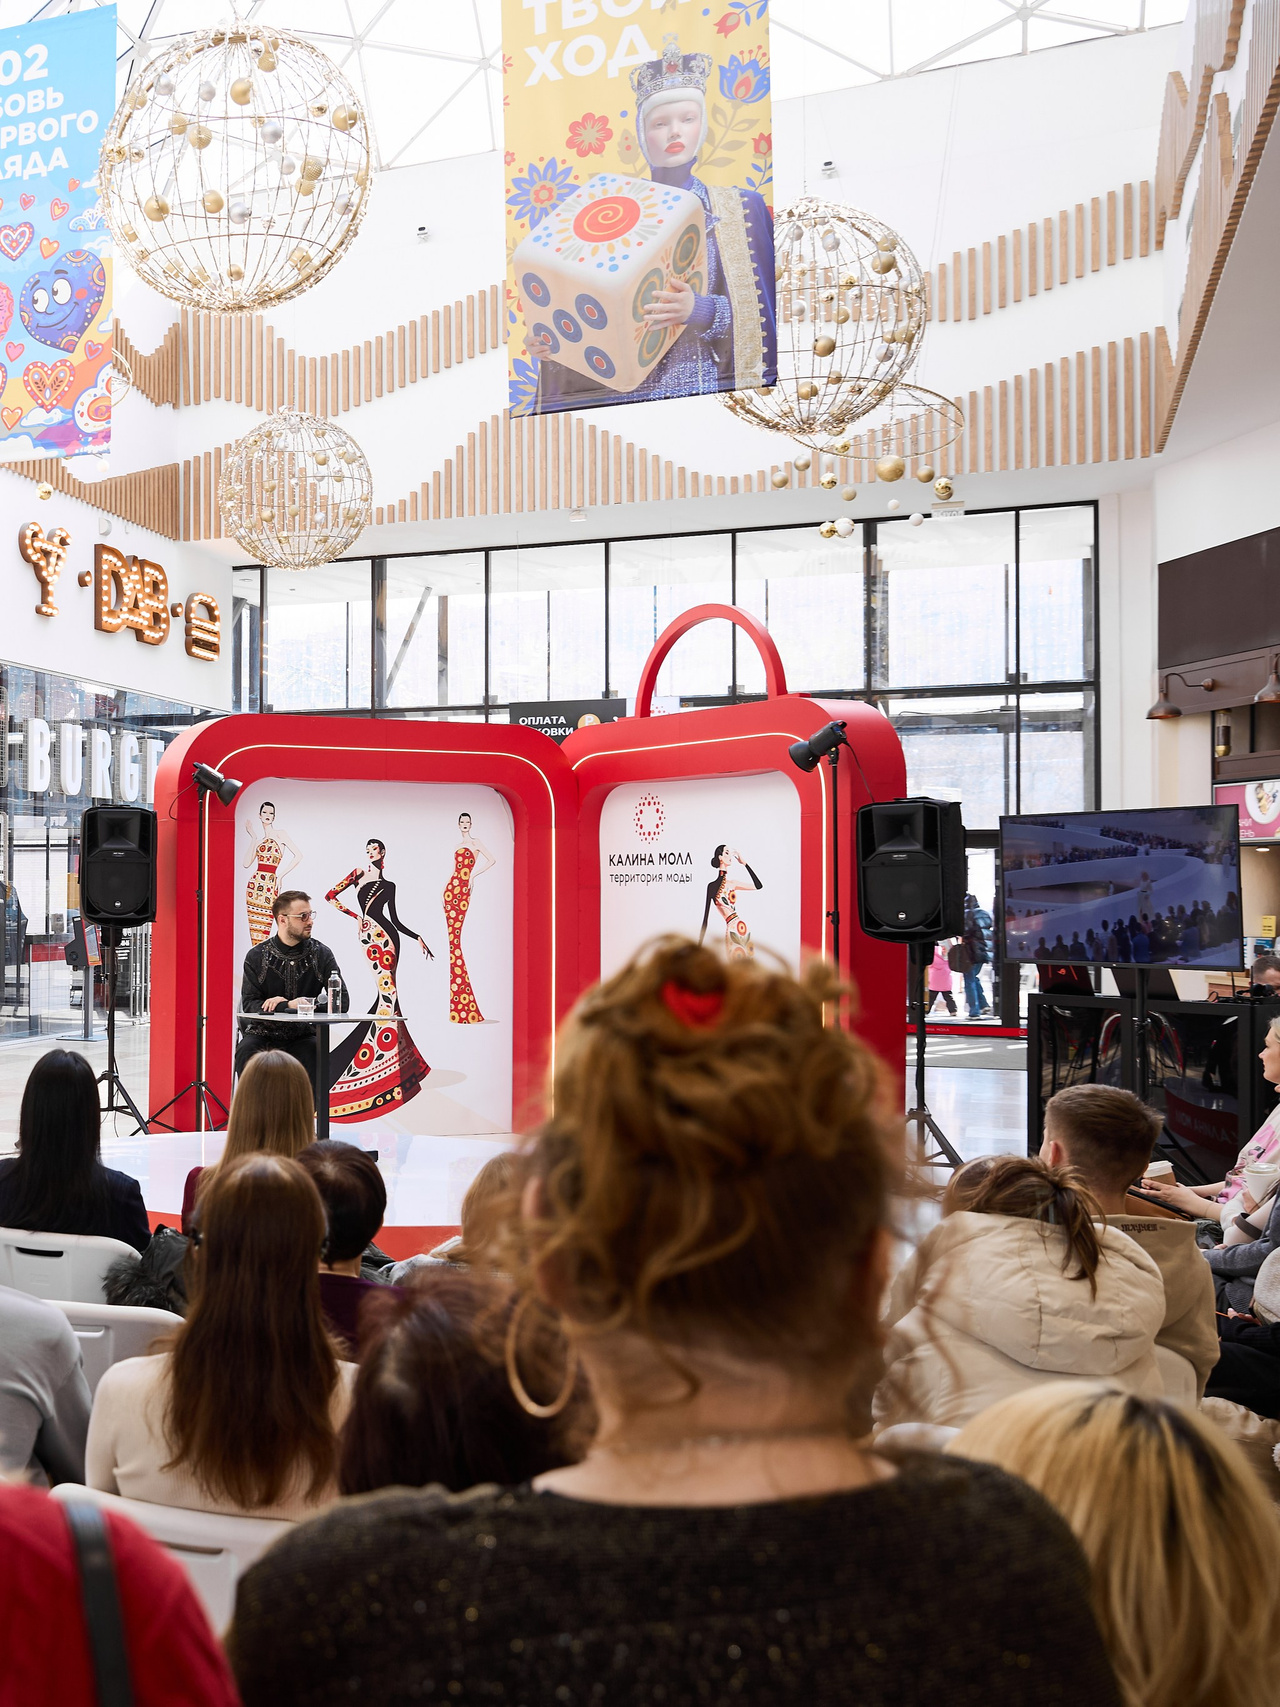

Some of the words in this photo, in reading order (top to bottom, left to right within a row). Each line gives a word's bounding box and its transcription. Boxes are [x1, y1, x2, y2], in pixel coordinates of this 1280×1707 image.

[522, 0, 692, 36] ТВ
[524, 24, 658, 87] ХОД
[519, 715, 566, 726] ОПЛАТА
[535, 727, 574, 737] ОВКИ
[609, 853, 655, 867] КАЛИНА
[658, 852, 693, 866] МОЛЛ
[609, 873, 663, 886] территория
[666, 873, 693, 884] моды
